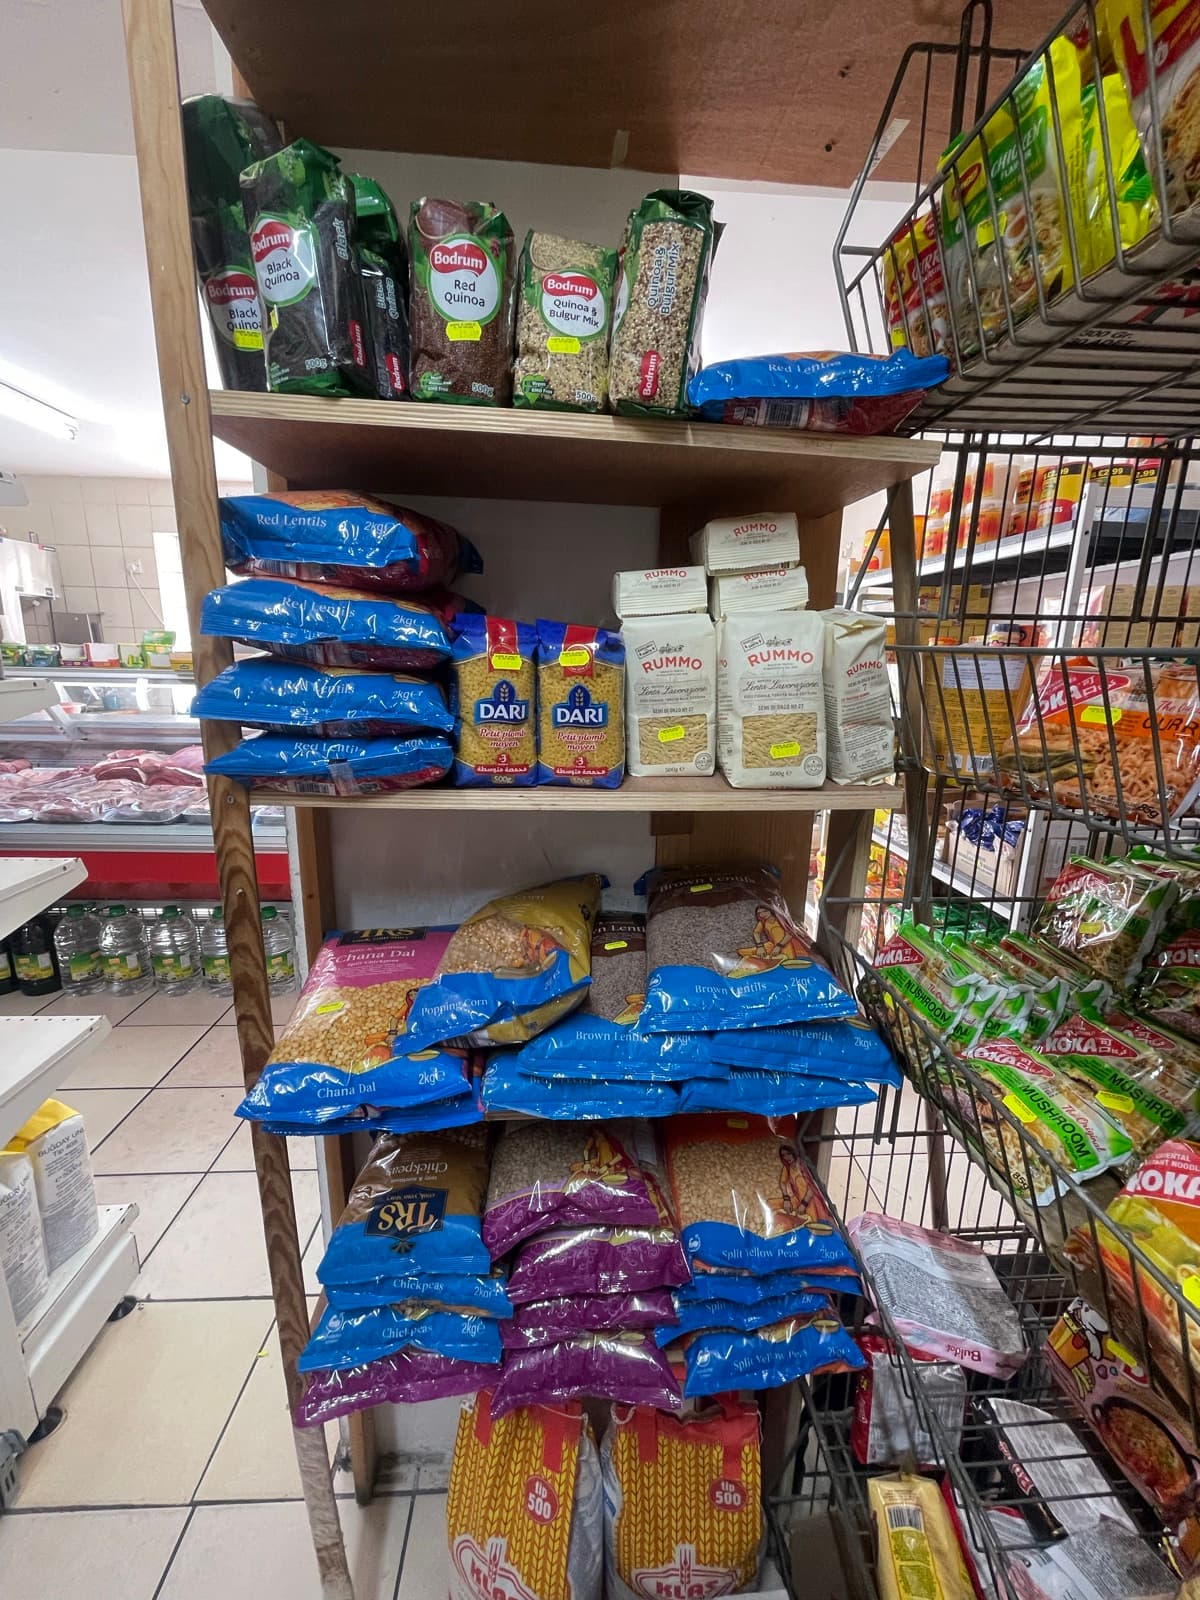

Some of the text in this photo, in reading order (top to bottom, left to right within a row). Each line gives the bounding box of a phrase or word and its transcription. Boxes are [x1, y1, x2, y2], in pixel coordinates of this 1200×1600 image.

[332, 217, 349, 261] Black
[267, 258, 292, 275] Black
[433, 251, 484, 269] Bodrum
[264, 270, 300, 290] Quinoa
[648, 246, 666, 308] Quinoa &
[660, 243, 680, 314] Bulgur Mix
[208, 284, 255, 298] Bodrum
[454, 279, 476, 292] Red
[547, 279, 594, 297] Bodrum
[444, 291, 486, 308] Quinoa
[229, 307, 258, 319] Black
[554, 299, 598, 317] Quinoa &
[550, 309, 600, 328] Bulgur Mix
[354, 323, 364, 366] Bodrum
[304, 357, 328, 370] 500g
[768, 363, 793, 373] Red
[393, 356, 403, 390] Bodrum
[643, 354, 657, 396] Bodrum
[471, 382, 494, 398] 500g
[1098, 467, 1123, 477] £299
[256, 513, 328, 528] Red Lentils
[733, 523, 777, 537] RUMMO
[644, 569, 687, 581] RUMMO
[743, 569, 787, 582] RUMMO
[282, 597, 308, 611] Red
[392, 614, 413, 627] 2kg
[642, 655, 702, 674] RUMMO
[747, 649, 814, 669] RUMMO
[846, 660, 883, 678] RUMMO
[391, 689, 414, 702] 2kg
[480, 703, 526, 720] DARI
[556, 708, 603, 724] DARI
[1142, 716, 1200, 734] CURR
[480, 727, 527, 740] Petit plomb
[577, 731, 605, 744] plomb
[489, 738, 520, 749] moyen
[566, 743, 597, 752] moyen
[498, 753, 507, 763] 3
[576, 756, 585, 766] 3
[1137, 803, 1160, 819] 85g
[611, 924, 646, 933] Lenti
[335, 951, 385, 964] Chana
[390, 949, 416, 958] Dal
[695, 981, 768, 997] Brown Lentils
[790, 976, 809, 988] 2kg
[421, 997, 488, 1017] Popping Corn
[575, 1031, 611, 1042] Brown
[800, 1029, 834, 1043] Lentils
[854, 1036, 871, 1048] 2kg
[1045, 1036, 1097, 1053] KOKA
[418, 1072, 436, 1086] 2kg
[316, 1081, 377, 1100] Chana Dal
[1018, 1082, 1091, 1159] MUSHROOM
[385, 1160, 449, 1176] Chickpeas
[1171, 1160, 1200, 1171] NOODL
[1012, 1171, 1030, 1190] 85g
[1125, 1168, 1200, 1200] KOKA
[377, 1201, 437, 1234] TRS
[721, 1248, 743, 1261] Split
[776, 1248, 800, 1259] Peas
[392, 1278, 445, 1293] Chickpeas
[381, 1323, 434, 1340] Chickpeas
[461, 1321, 479, 1336] 2kg
[732, 1358, 754, 1373] Split
[535, 1480, 548, 1496] tip
[720, 1480, 736, 1494] tip
[526, 1493, 551, 1519] 500
[714, 1491, 741, 1506] 500
[470, 1557, 520, 1600] KLA
[655, 1580, 720, 1600] KLAS
